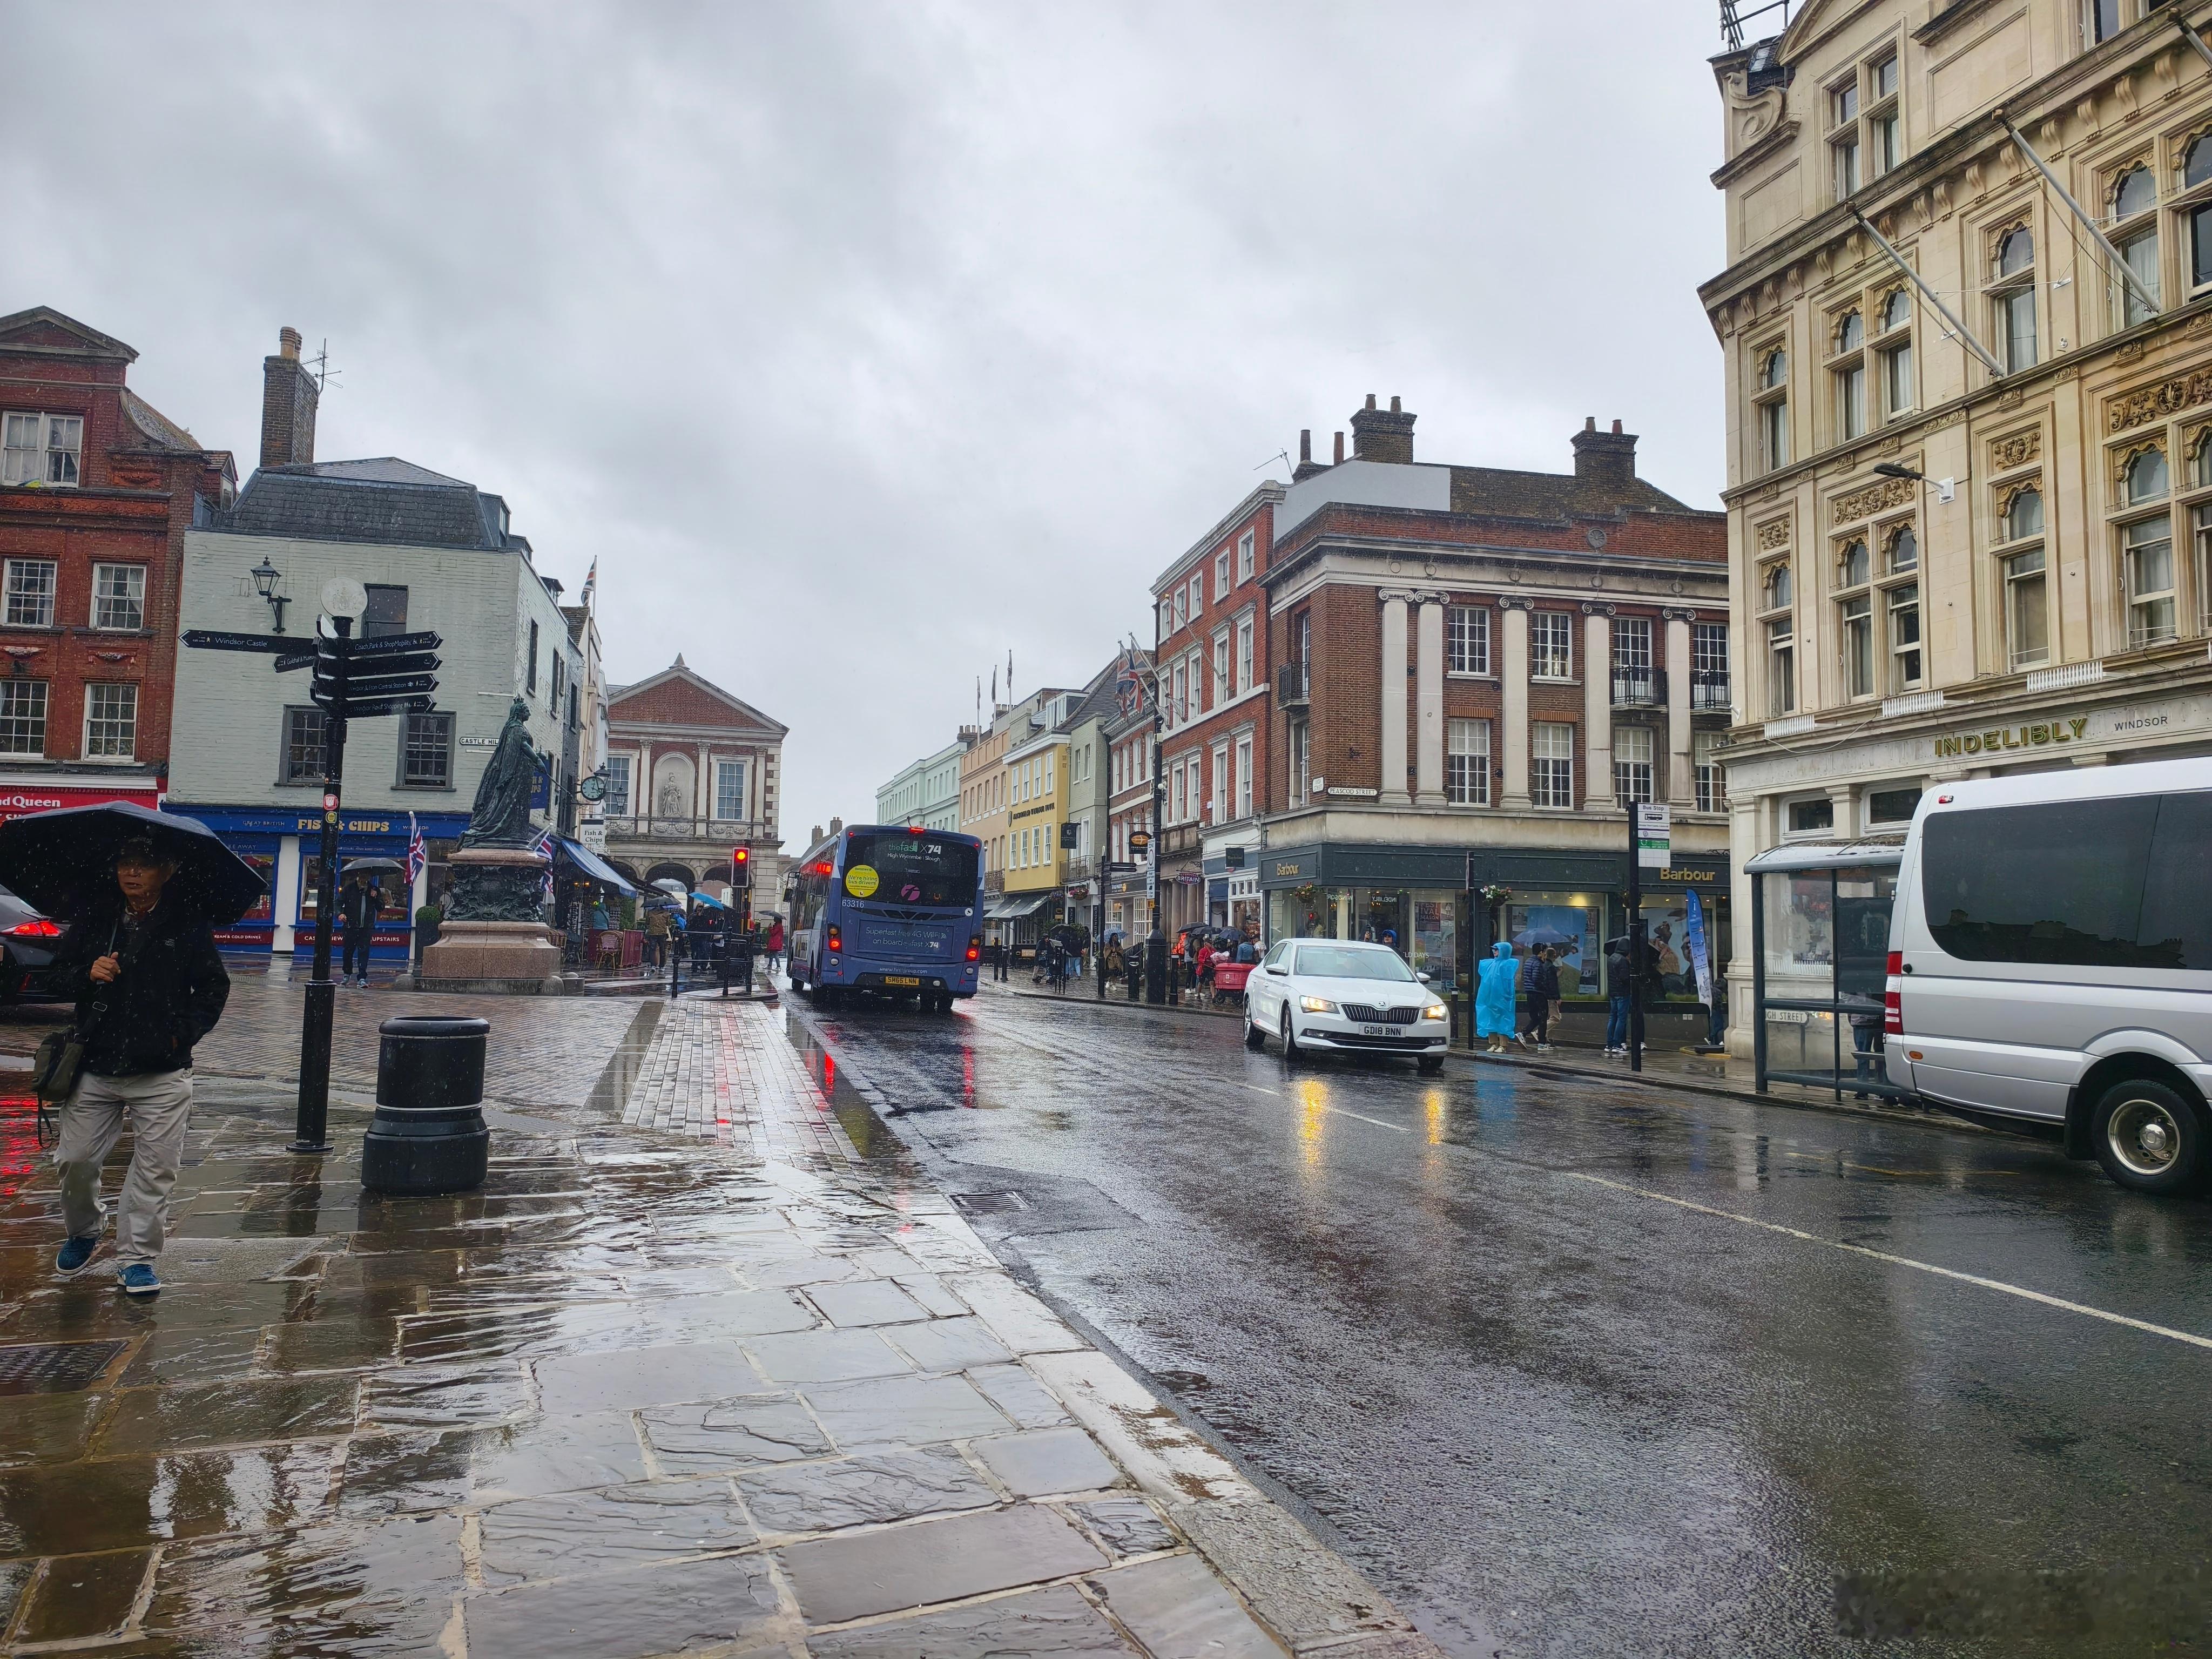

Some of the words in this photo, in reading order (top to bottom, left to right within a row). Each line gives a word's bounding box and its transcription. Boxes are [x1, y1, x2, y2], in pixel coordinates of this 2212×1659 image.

[215, 637, 245, 646] Windsor
[2114, 716, 2168, 731] WINDSOR
[1935, 718, 2087, 756] INDELIBLY
[12, 795, 60, 808] Queen
[298, 819, 321, 830] FIS
[349, 821, 389, 832] CHIPS
[1277, 863, 1299, 876] Barbour
[1660, 867, 1715, 881] Barbour
[842, 899, 864, 908] 63316
[866, 927, 896, 935] Superfast
[883, 938, 903, 946] board
[1779, 1012, 1803, 1021] STREET
[1364, 1026, 1382, 1035] GD18
[1385, 1027, 1401, 1036] BNN
